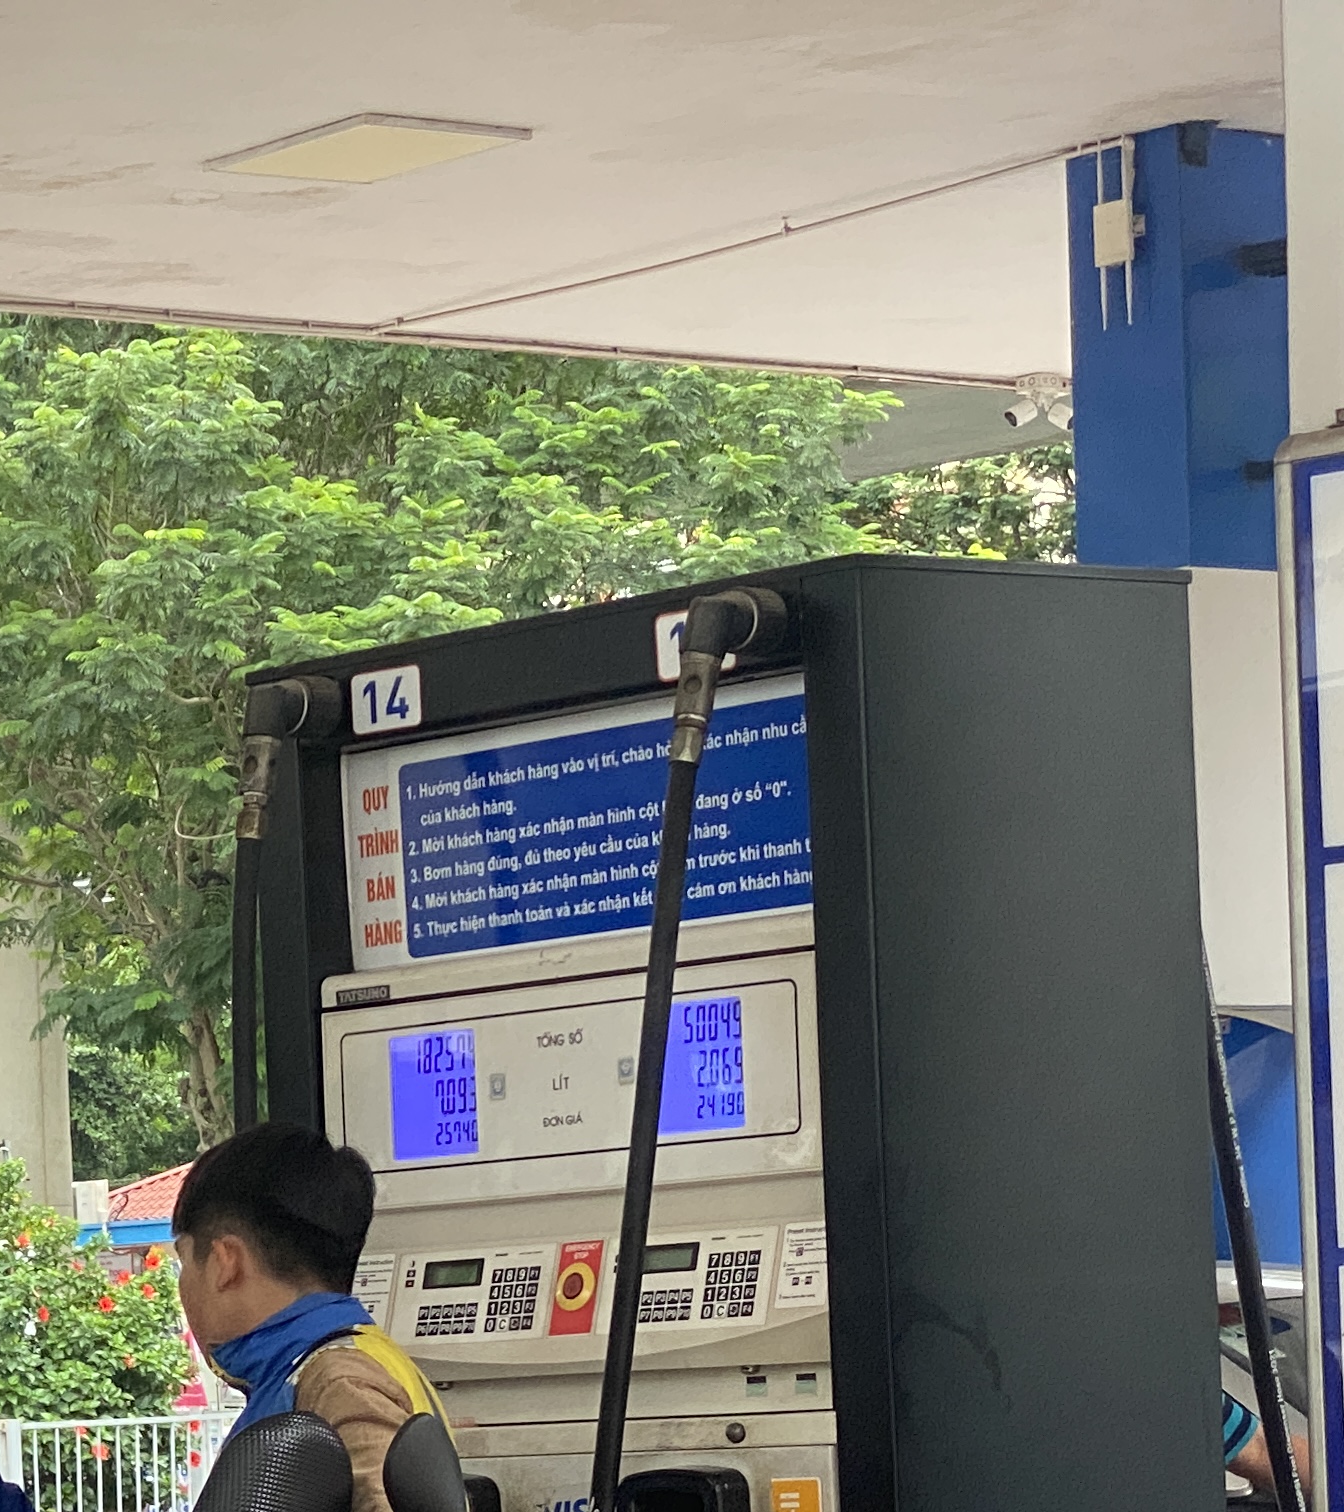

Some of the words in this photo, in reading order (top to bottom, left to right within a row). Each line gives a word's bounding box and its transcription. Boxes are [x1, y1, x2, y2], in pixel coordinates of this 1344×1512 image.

[363, 675, 410, 724] 14
[419, 779, 461, 799] Hướng
[463, 771, 486, 791] dẫn
[488, 767, 525, 787] khách
[528, 762, 559, 780] hàng
[562, 757, 584, 774] vào
[587, 752, 599, 772] vị
[622, 743, 653, 765] chào
[725, 727, 759, 748] nhận
[762, 723, 788, 740] nhu
[363, 785, 389, 815] QUY
[420, 809, 442, 826] của
[444, 803, 481, 823] khách
[483, 798, 518, 817] hàng.
[422, 835, 445, 854] Mời
[447, 830, 483, 850] khách
[485, 826, 516, 845] hàng
[518, 821, 541, 839] xác
[543, 816, 575, 836] nhận
[577, 809, 605, 828] màn
[607, 805, 636, 824] hình
[638, 802, 660, 823] cột
[695, 792, 729, 811] đang
[745, 781, 762, 803] số
[358, 827, 399, 858] TRÌNH
[423, 865, 452, 882] Bơm
[454, 859, 485, 878] hàng
[543, 846, 571, 862] theo
[573, 841, 597, 862] yêu
[599, 833, 622, 855] cầu
[625, 832, 649, 849] của
[366, 872, 395, 902] BÁN
[425, 890, 448, 909] Mời
[450, 884, 487, 904] khách
[488, 880, 520, 900] hàng
[521, 875, 544, 893] xác
[546, 872, 578, 891] nhận
[580, 866, 608, 886] màn
[610, 862, 639, 881] hình
[698, 849, 737, 869] trước
[739, 845, 760, 863] khi
[763, 840, 803, 860] thanh
[427, 918, 458, 938] Thực
[460, 914, 486, 932] hiện
[488, 908, 523, 928] thanh
[525, 904, 553, 922] toán
[556, 904, 571, 919] và
[573, 898, 596, 917] xác
[598, 894, 631, 914] nhận
[633, 887, 654, 908] kết
[718, 880, 736, 895] ơn
[739, 872, 781, 892] khách
[365, 918, 402, 948] HÀNG
[338, 986, 388, 1004] TATSUNO
[537, 1032, 565, 1049] TỔNG
[569, 1028, 584, 1045] SỐ
[552, 1074, 569, 1091] LÍT
[435, 1119, 479, 1146] 25740
[565, 1111, 583, 1125] GIÁ
